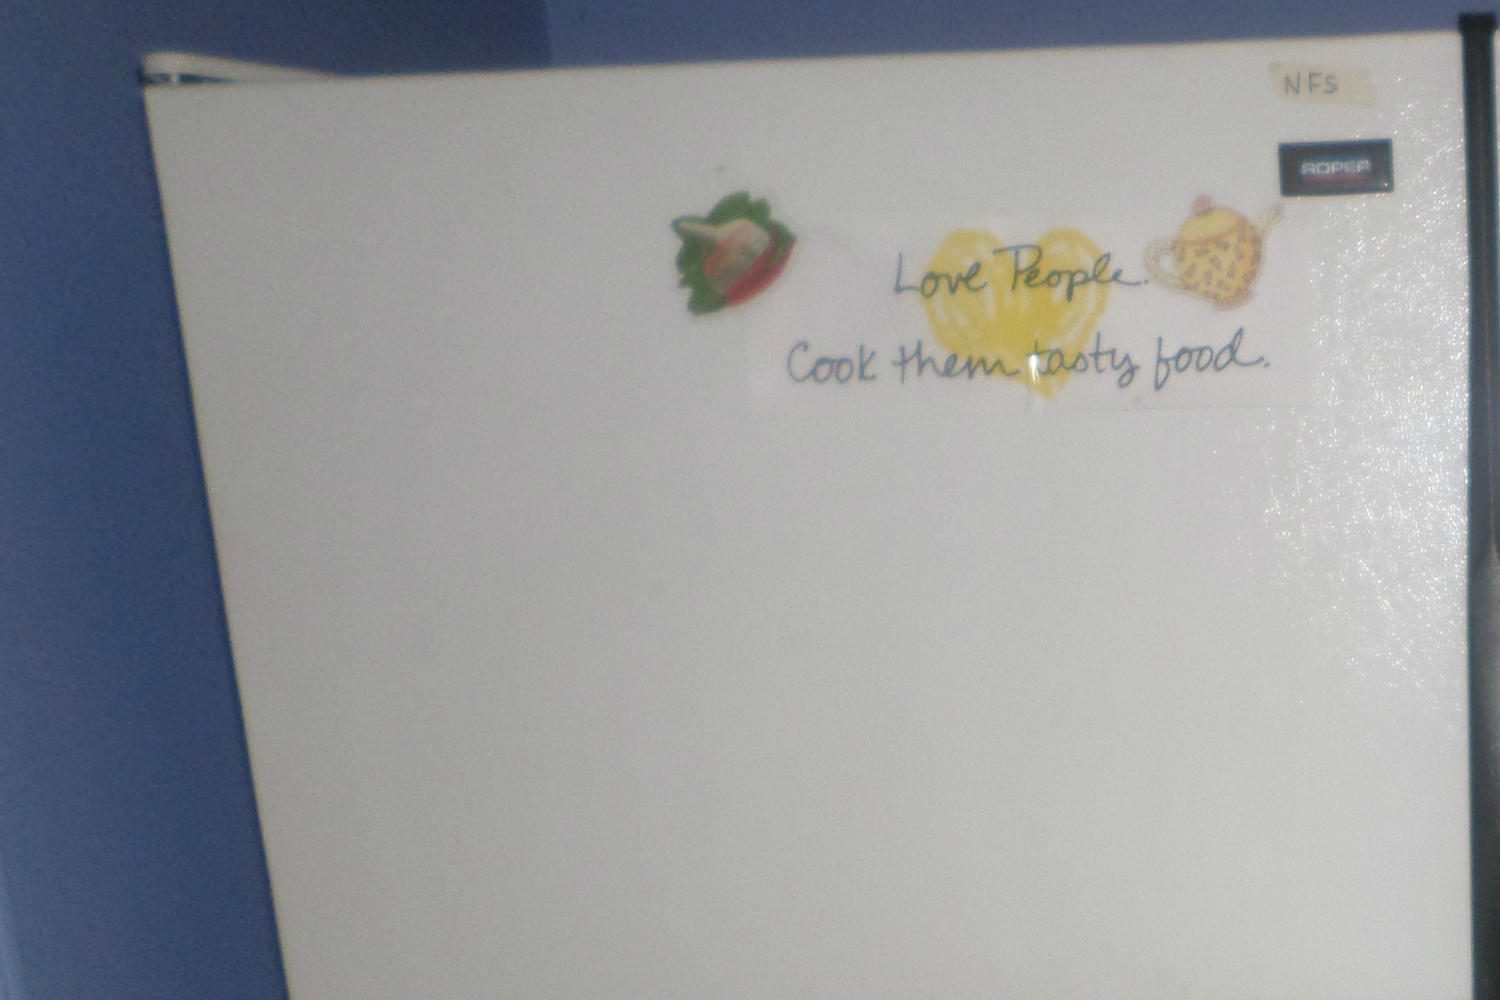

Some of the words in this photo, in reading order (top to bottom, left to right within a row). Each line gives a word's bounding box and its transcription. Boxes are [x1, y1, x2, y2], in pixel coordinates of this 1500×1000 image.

[1284, 71, 1339, 95] NFS
[893, 252, 987, 298] Love
[993, 243, 1149, 302] People.
[786, 339, 877, 384] Cook
[893, 339, 1021, 385] them
[1026, 331, 1140, 388] tasty
[1154, 326, 1272, 392] food.
